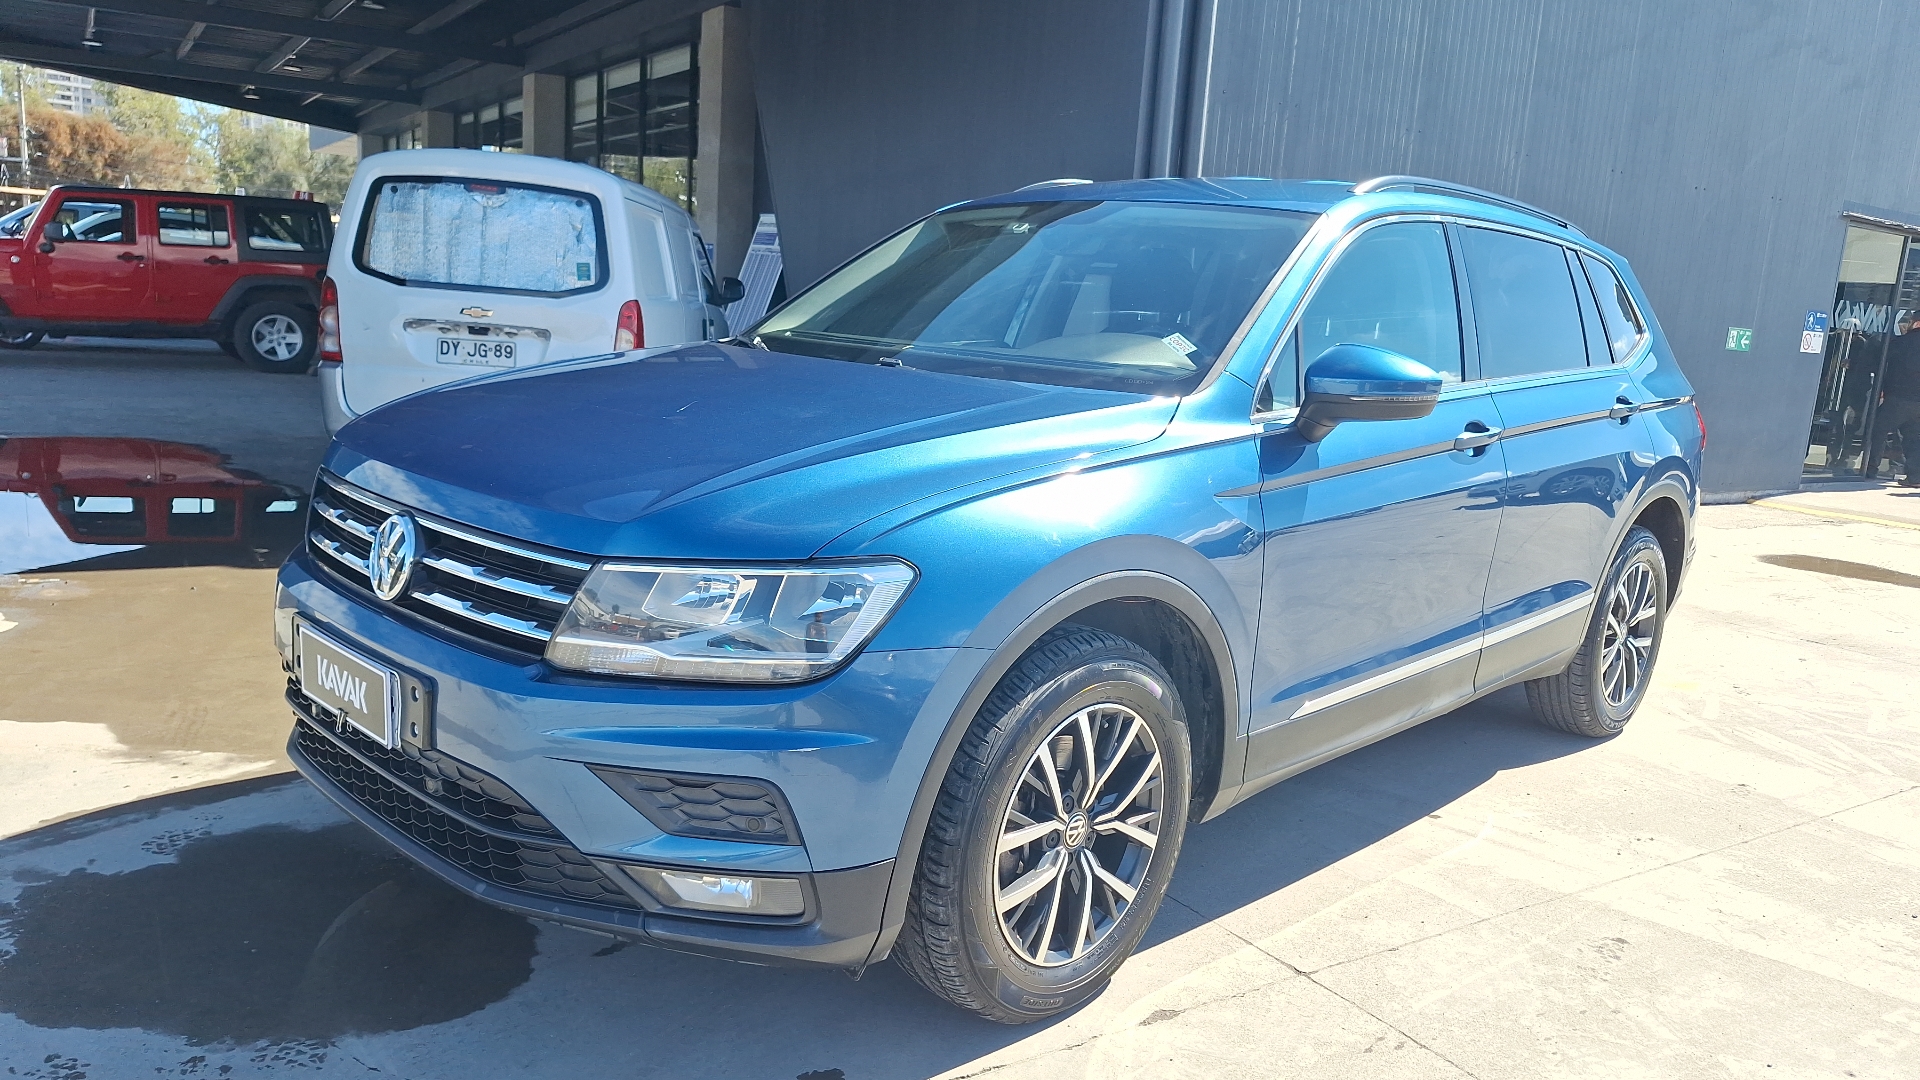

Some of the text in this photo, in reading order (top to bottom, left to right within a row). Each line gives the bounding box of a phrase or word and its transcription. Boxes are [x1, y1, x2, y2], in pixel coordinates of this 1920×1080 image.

[440, 340, 513, 359] DY JG 89
[317, 655, 367, 714] KAVAK
[1023, 998, 1061, 1009] OUTSIDE
